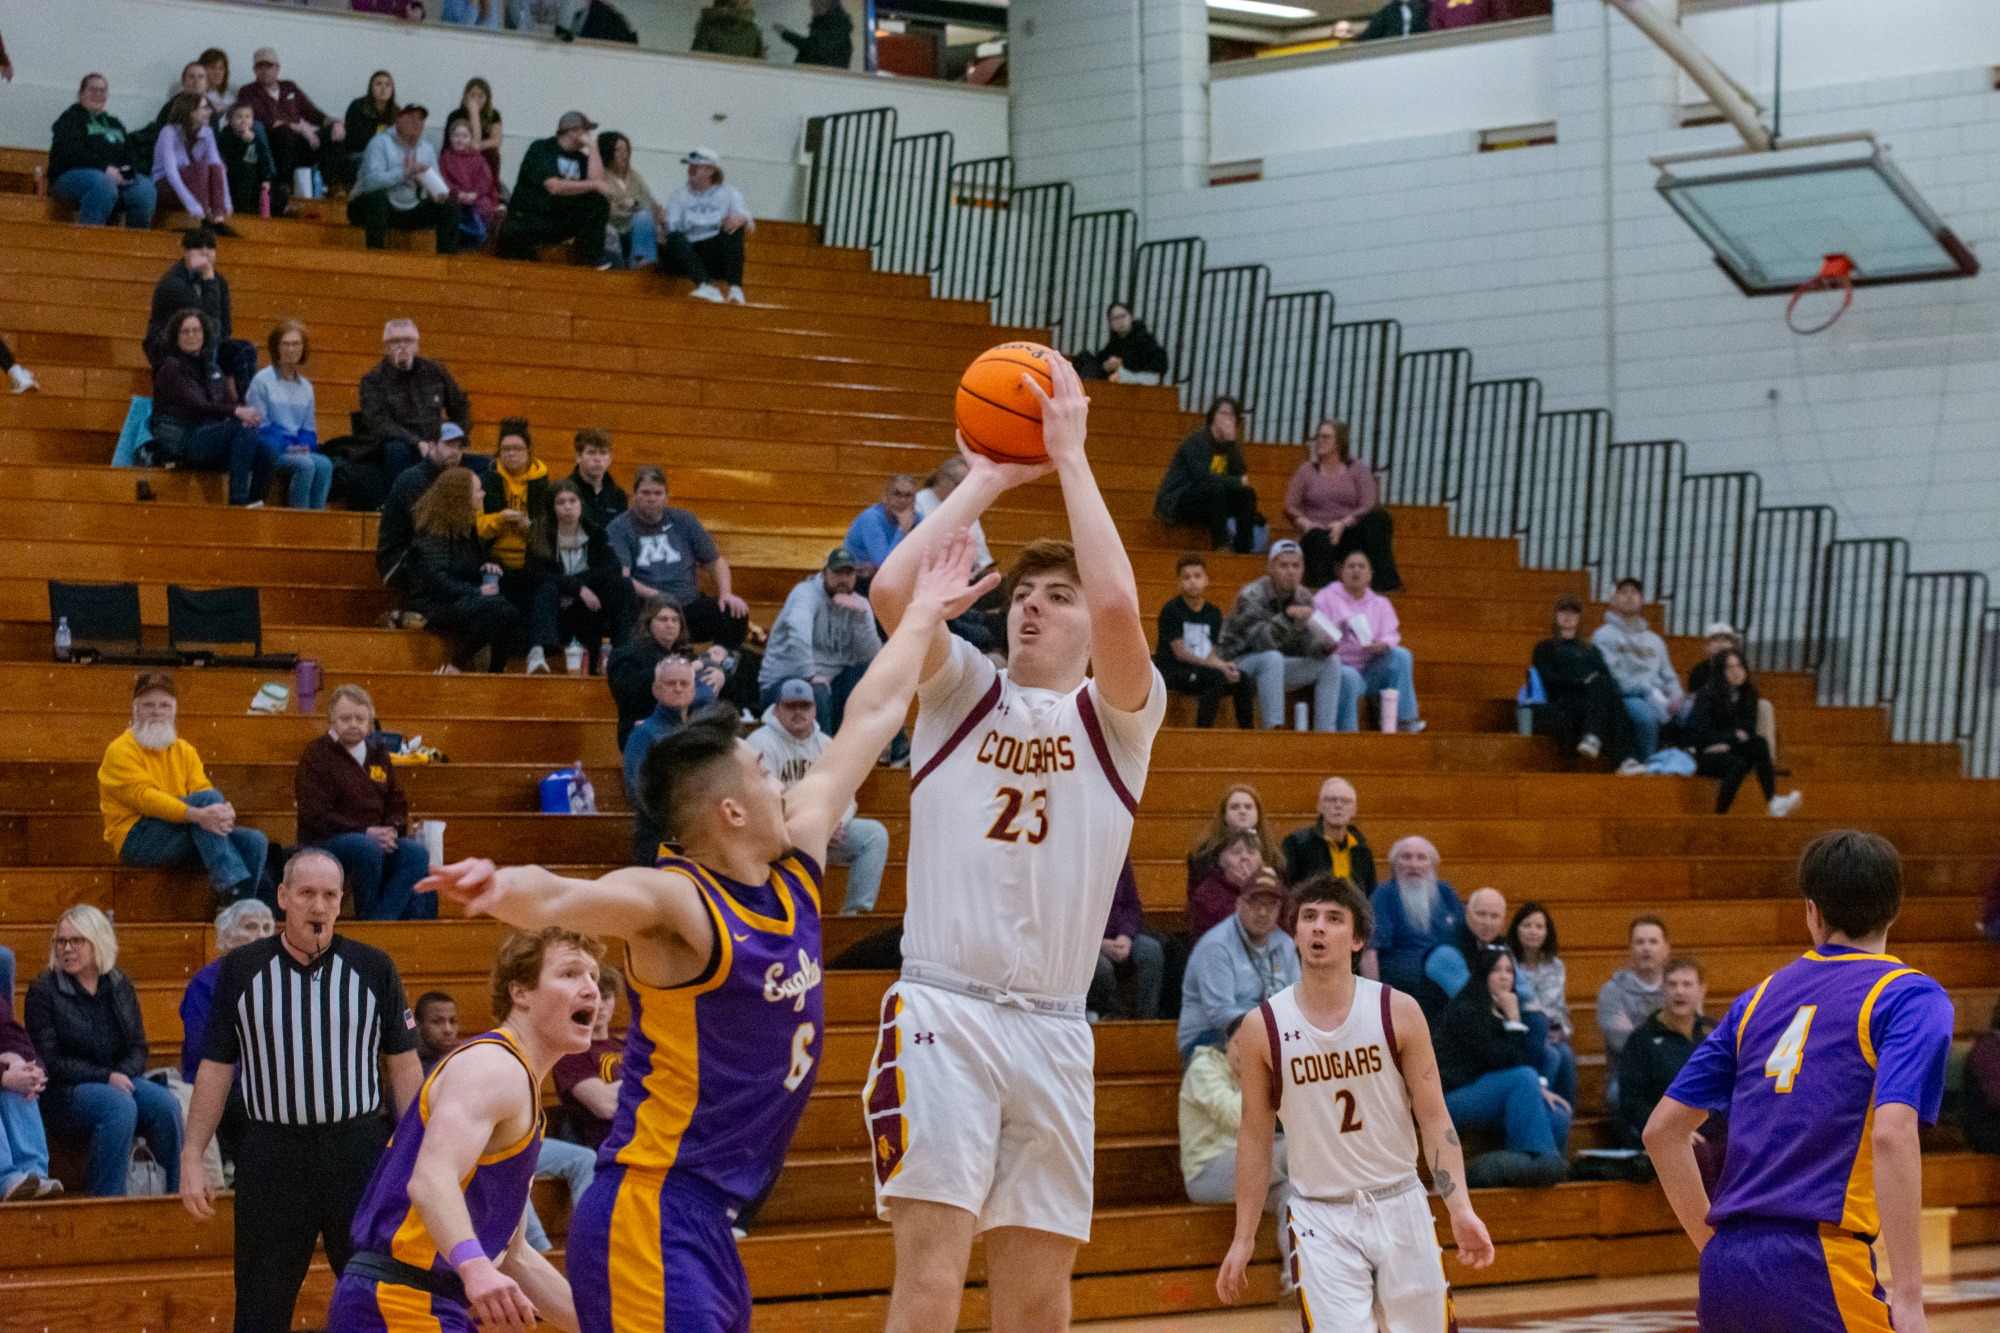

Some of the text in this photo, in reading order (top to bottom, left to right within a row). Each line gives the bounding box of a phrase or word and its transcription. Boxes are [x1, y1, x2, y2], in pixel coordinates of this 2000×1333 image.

[636, 534, 681, 567] M
[985, 786, 1050, 845] 23
[784, 1021, 815, 1092] 6
[1290, 1044, 1382, 1086] COUGARS
[1764, 1005, 1817, 1093] 4
[1335, 1088, 1363, 1133] 2
